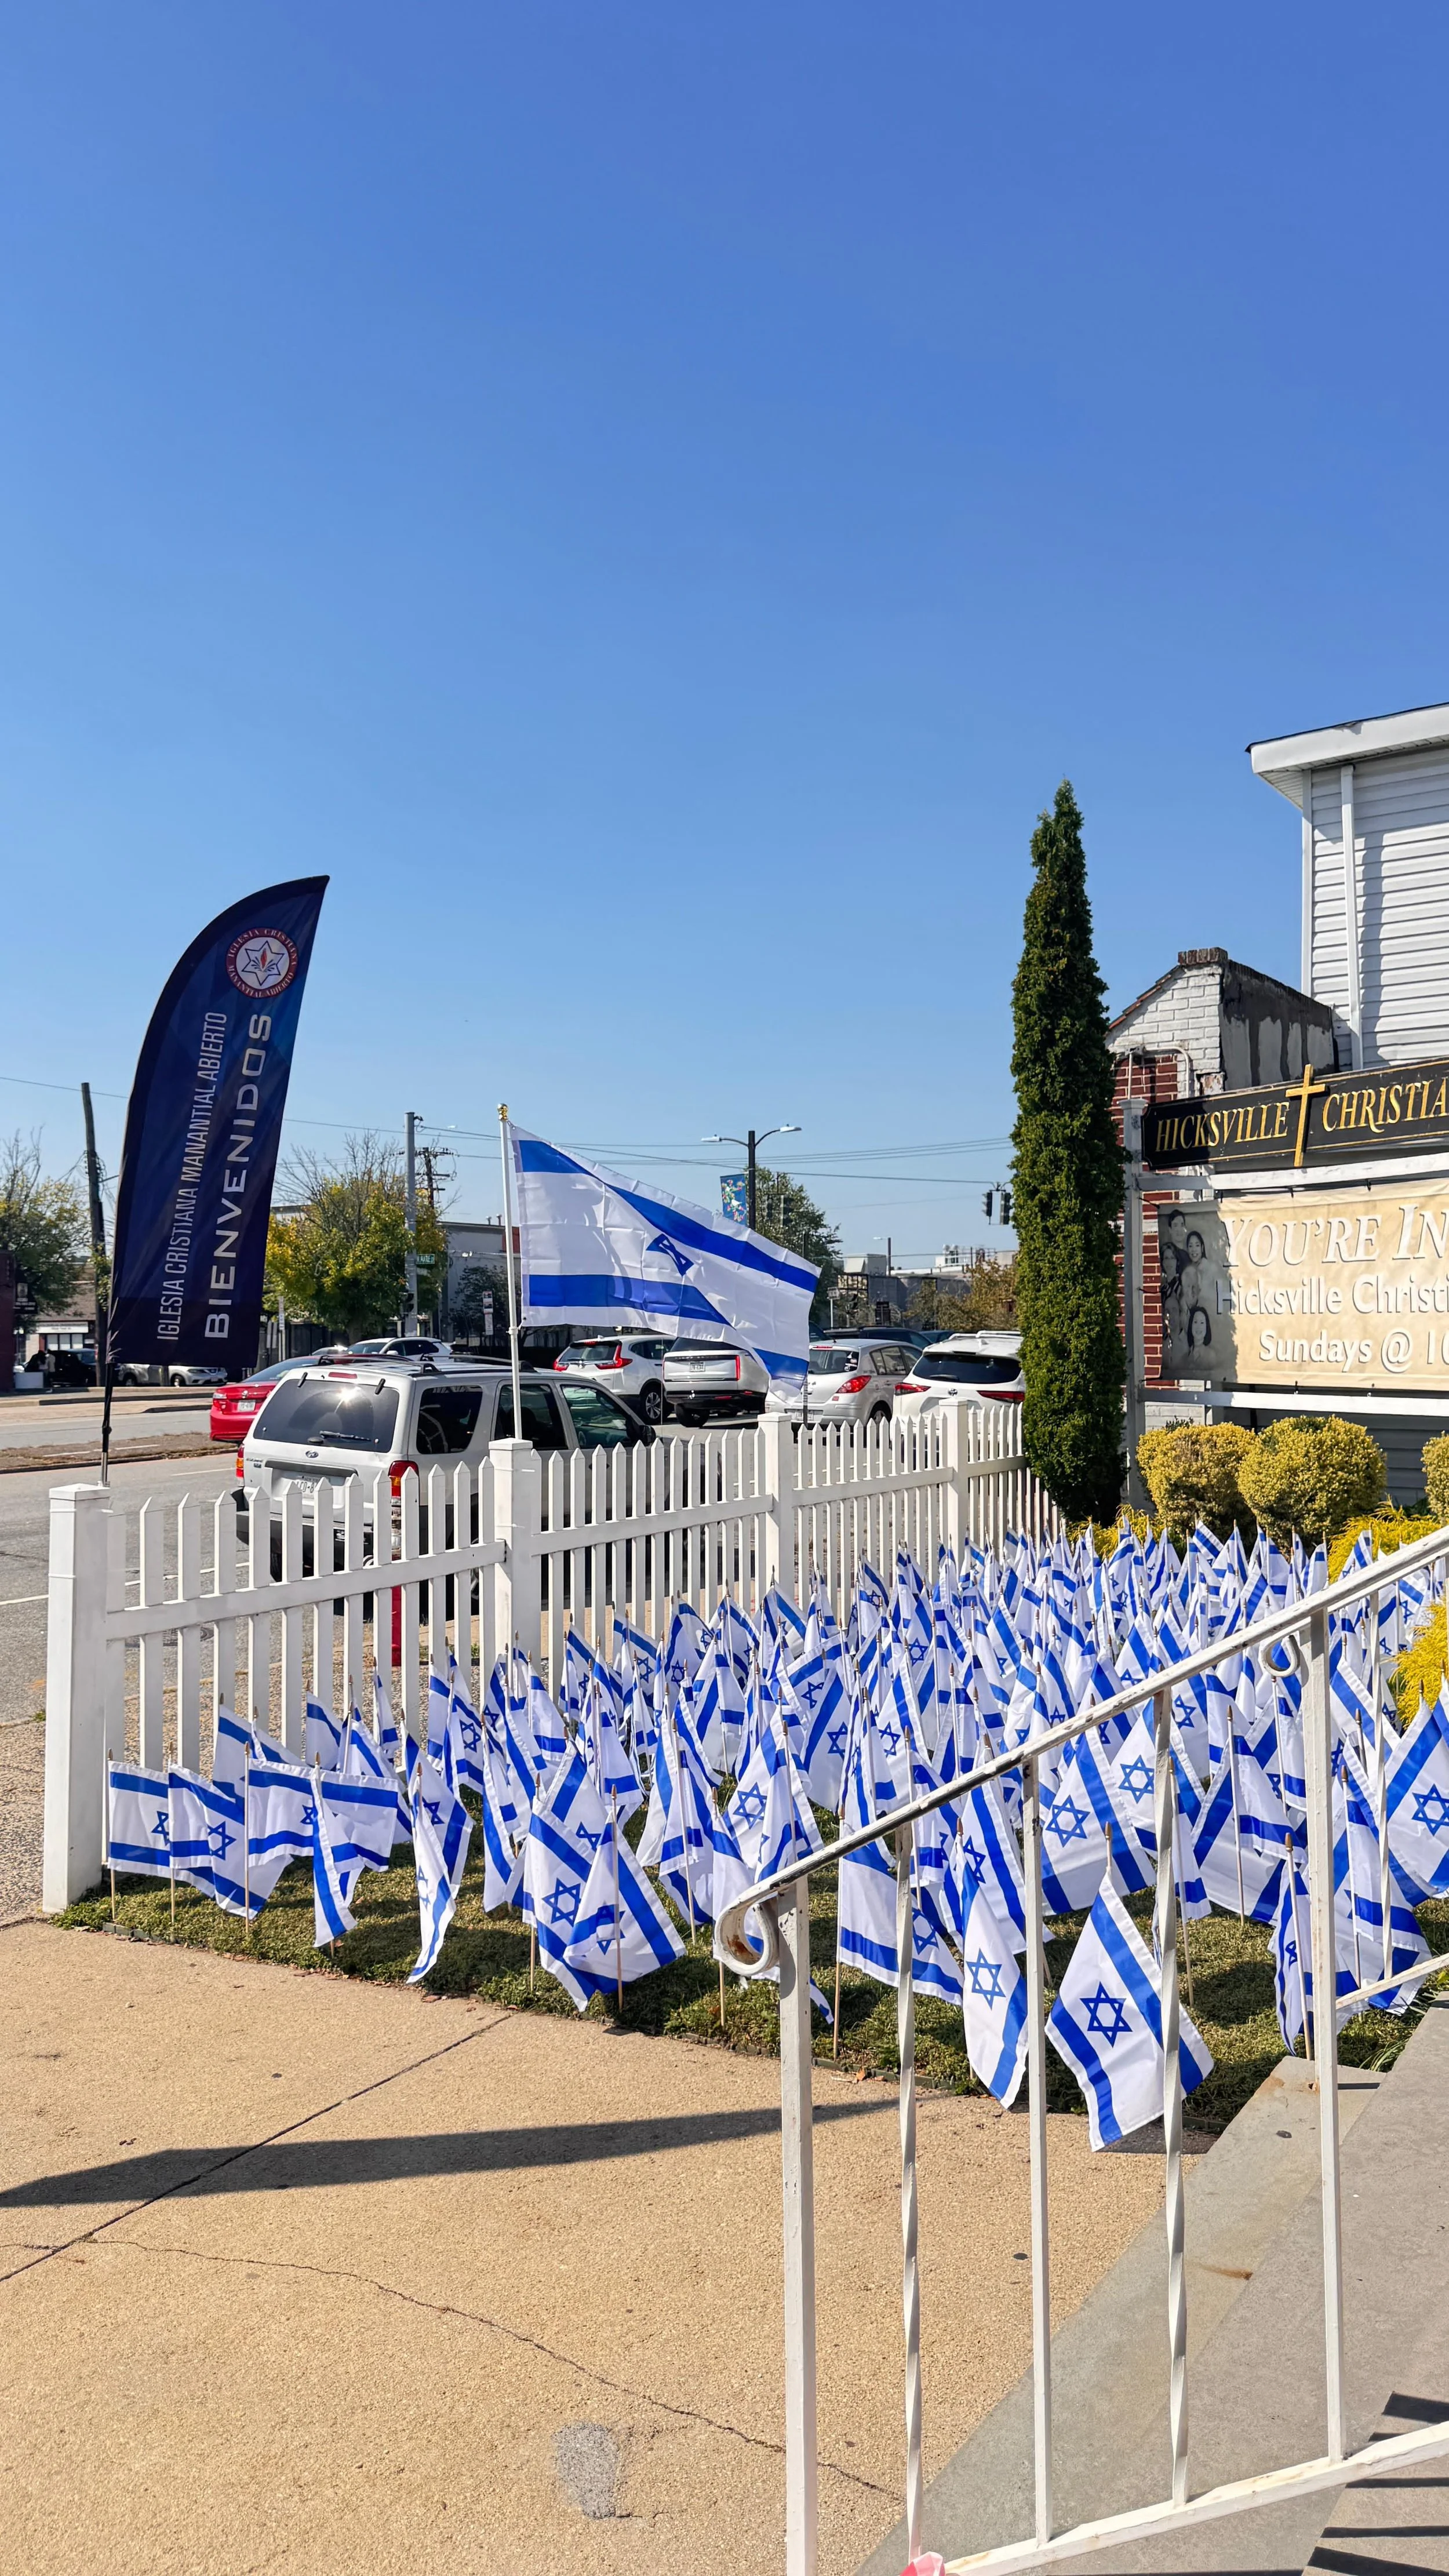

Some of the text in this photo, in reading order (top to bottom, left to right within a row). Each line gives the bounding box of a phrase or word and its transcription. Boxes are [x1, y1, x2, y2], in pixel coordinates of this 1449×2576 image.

[1155, 1101, 1290, 1152] HICKSVILLE
[156, 1012, 227, 1340] IGLESIA CRISTIANA MANANTIAL ABIERTO
[204, 1014, 272, 1338] BIENVENIDOS
[1220, 1214, 1382, 1267] YOU'RE
[1215, 1275, 1343, 1315] Hicksville
[1258, 1328, 1374, 1373] Sundays
[1380, 1327, 1413, 1374] @
